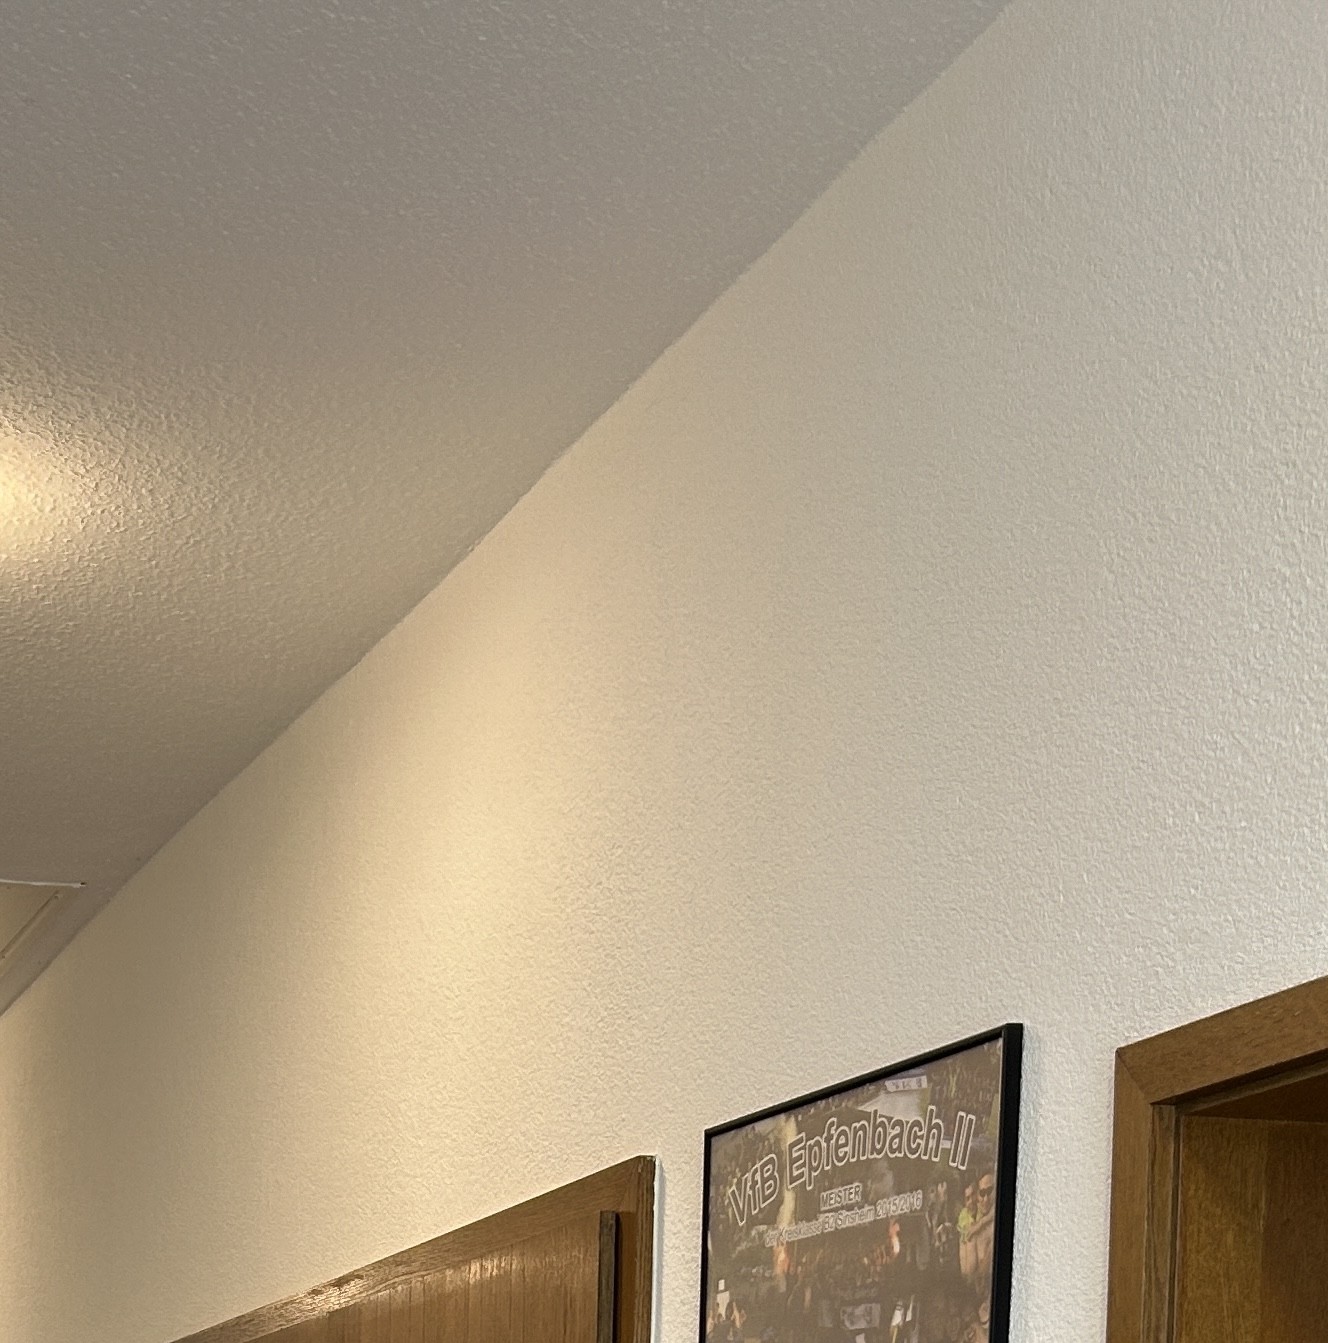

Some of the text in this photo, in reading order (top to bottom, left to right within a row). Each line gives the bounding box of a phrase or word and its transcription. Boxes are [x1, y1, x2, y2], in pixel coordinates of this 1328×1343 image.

[728, 1105, 976, 1227] VfB Epfenbach II
[820, 1182, 863, 1211] MEISTER
[875, 1189, 924, 1218] 2015/2016
